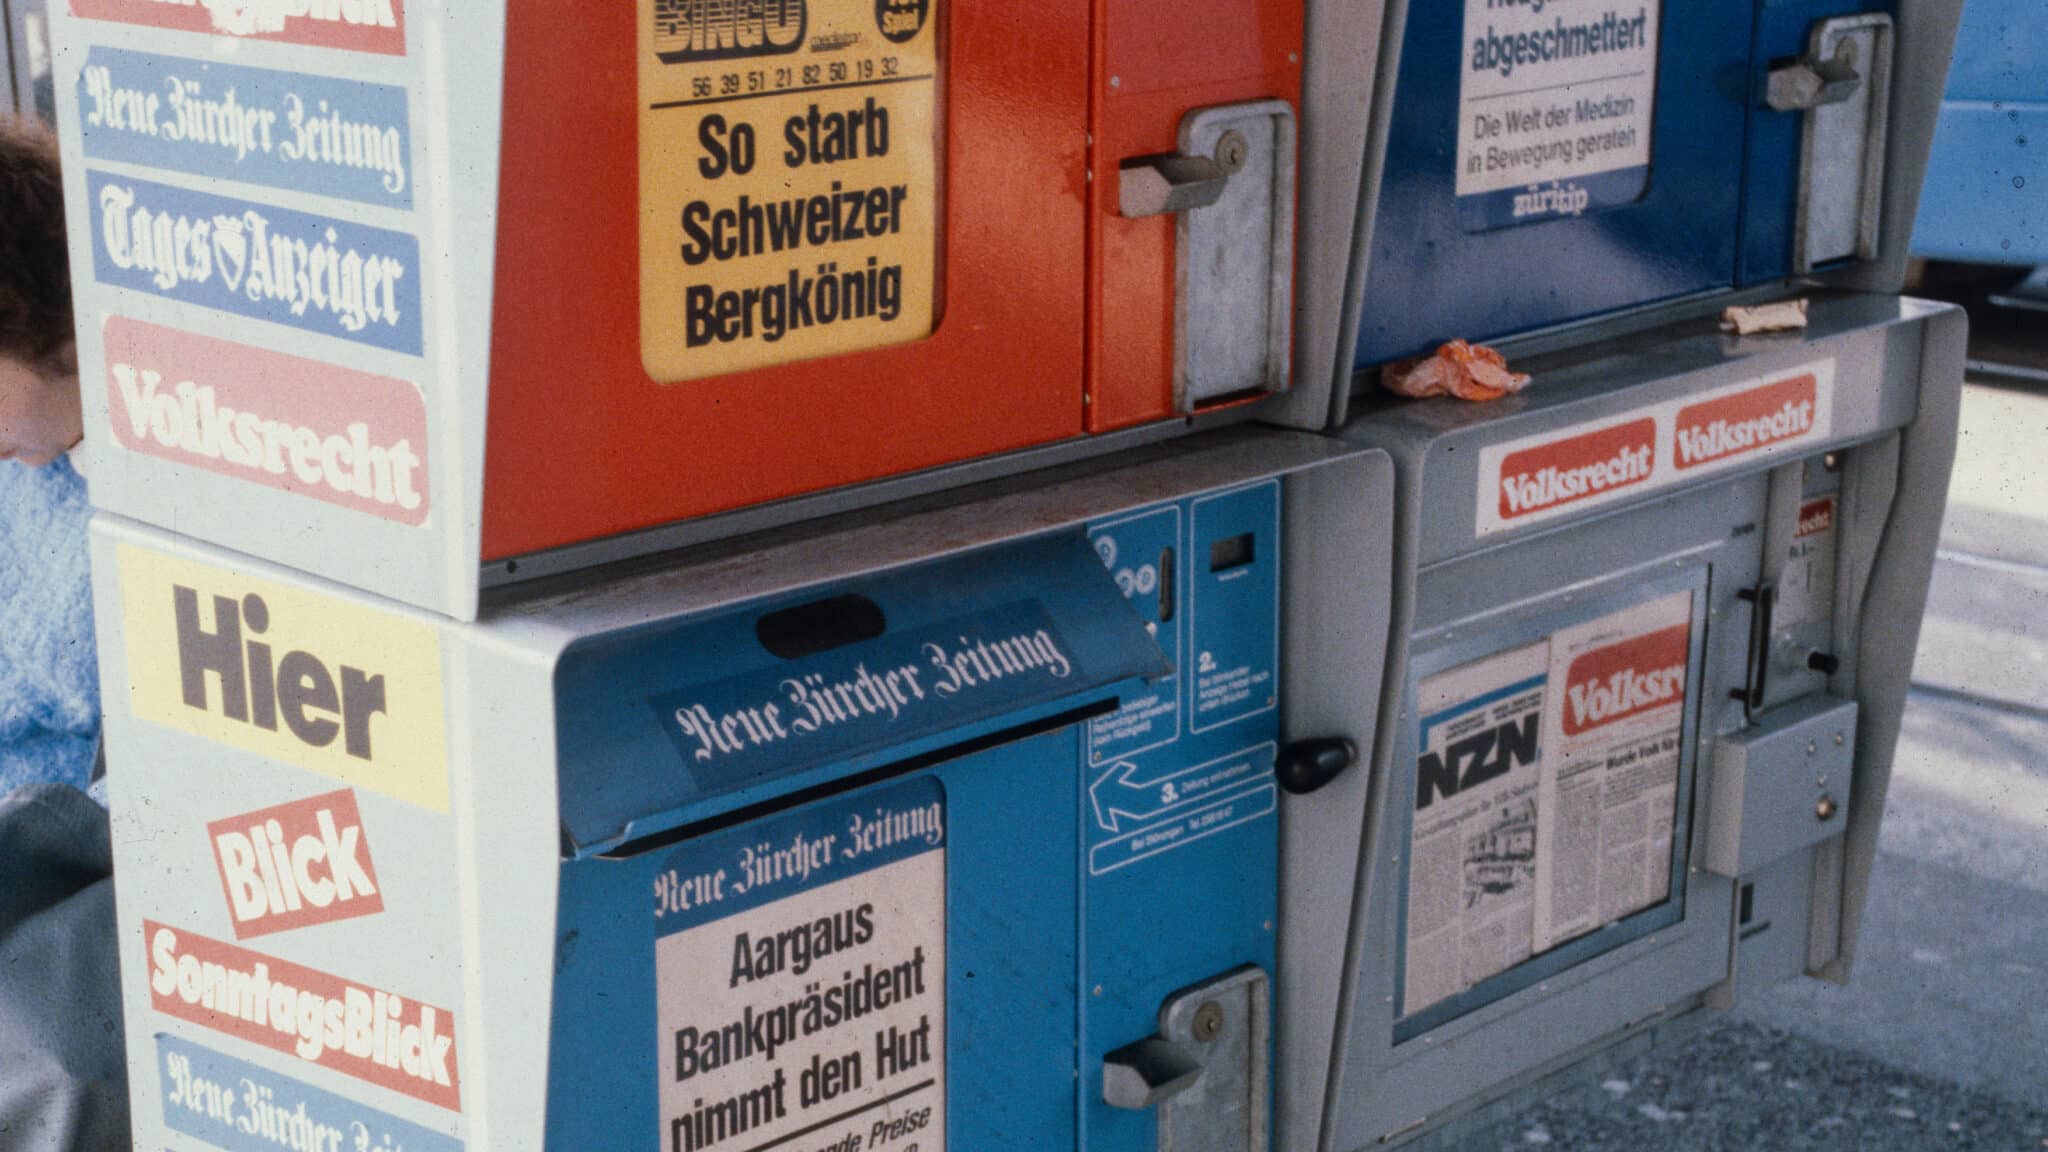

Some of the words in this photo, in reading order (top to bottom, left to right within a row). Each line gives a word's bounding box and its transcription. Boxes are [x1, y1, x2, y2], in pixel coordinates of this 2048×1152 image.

[653, 0, 806, 52] BINGO
[1471, 7, 1646, 77] abgeschmettert
[692, 77, 712, 97] 56
[720, 74, 739, 94] 39
[749, 71, 765, 90] 51
[775, 67, 793, 88] 21
[802, 65, 820, 85] 82
[829, 62, 847, 82] 50
[857, 59, 873, 79] 19
[881, 57, 899, 76] 32
[1474, 114, 1501, 140] Die
[1505, 106, 1541, 134] Welt
[1544, 103, 1571, 128] der
[1574, 93, 1635, 123] Medizin
[85, 65, 159, 136] Neue
[162, 74, 276, 162] Zürcher
[280, 92, 405, 193] Zeitung
[698, 113, 756, 181] So
[784, 97, 889, 169] starb
[1466, 153, 1482, 174] in
[1486, 136, 1572, 170] Bewegung
[1576, 126, 1637, 162] geraten
[101, 184, 215, 290] Tages
[244, 210, 404, 332] Anzeiger
[681, 180, 908, 267] Schweizer
[685, 256, 903, 349] Bergkönig
[112, 363, 422, 509] Volksrecht
[1503, 444, 1652, 513] Volksrecht
[1677, 400, 1812, 464] Volksrecht
[173, 583, 388, 761] Hier
[675, 702, 787, 762] Neue
[779, 661, 925, 735] Zürcher
[921, 629, 1072, 699] Zeitung
[1160, 782, 1180, 804] 3.
[1416, 711, 1540, 810] NZN
[215, 809, 377, 922] Blick
[654, 868, 727, 919] Neue
[732, 833, 837, 894] Zürcher
[841, 801, 944, 859] Zeitung
[728, 903, 875, 990] Aargaus
[152, 928, 454, 1088] SonntagsBlick
[674, 946, 926, 1083] Bankpräsident
[167, 1051, 236, 1126] Neue
[671, 1069, 787, 1152] nimmt
[800, 1050, 863, 1110] den
[875, 1016, 932, 1081] Hut
[869, 1107, 932, 1150] Preise
